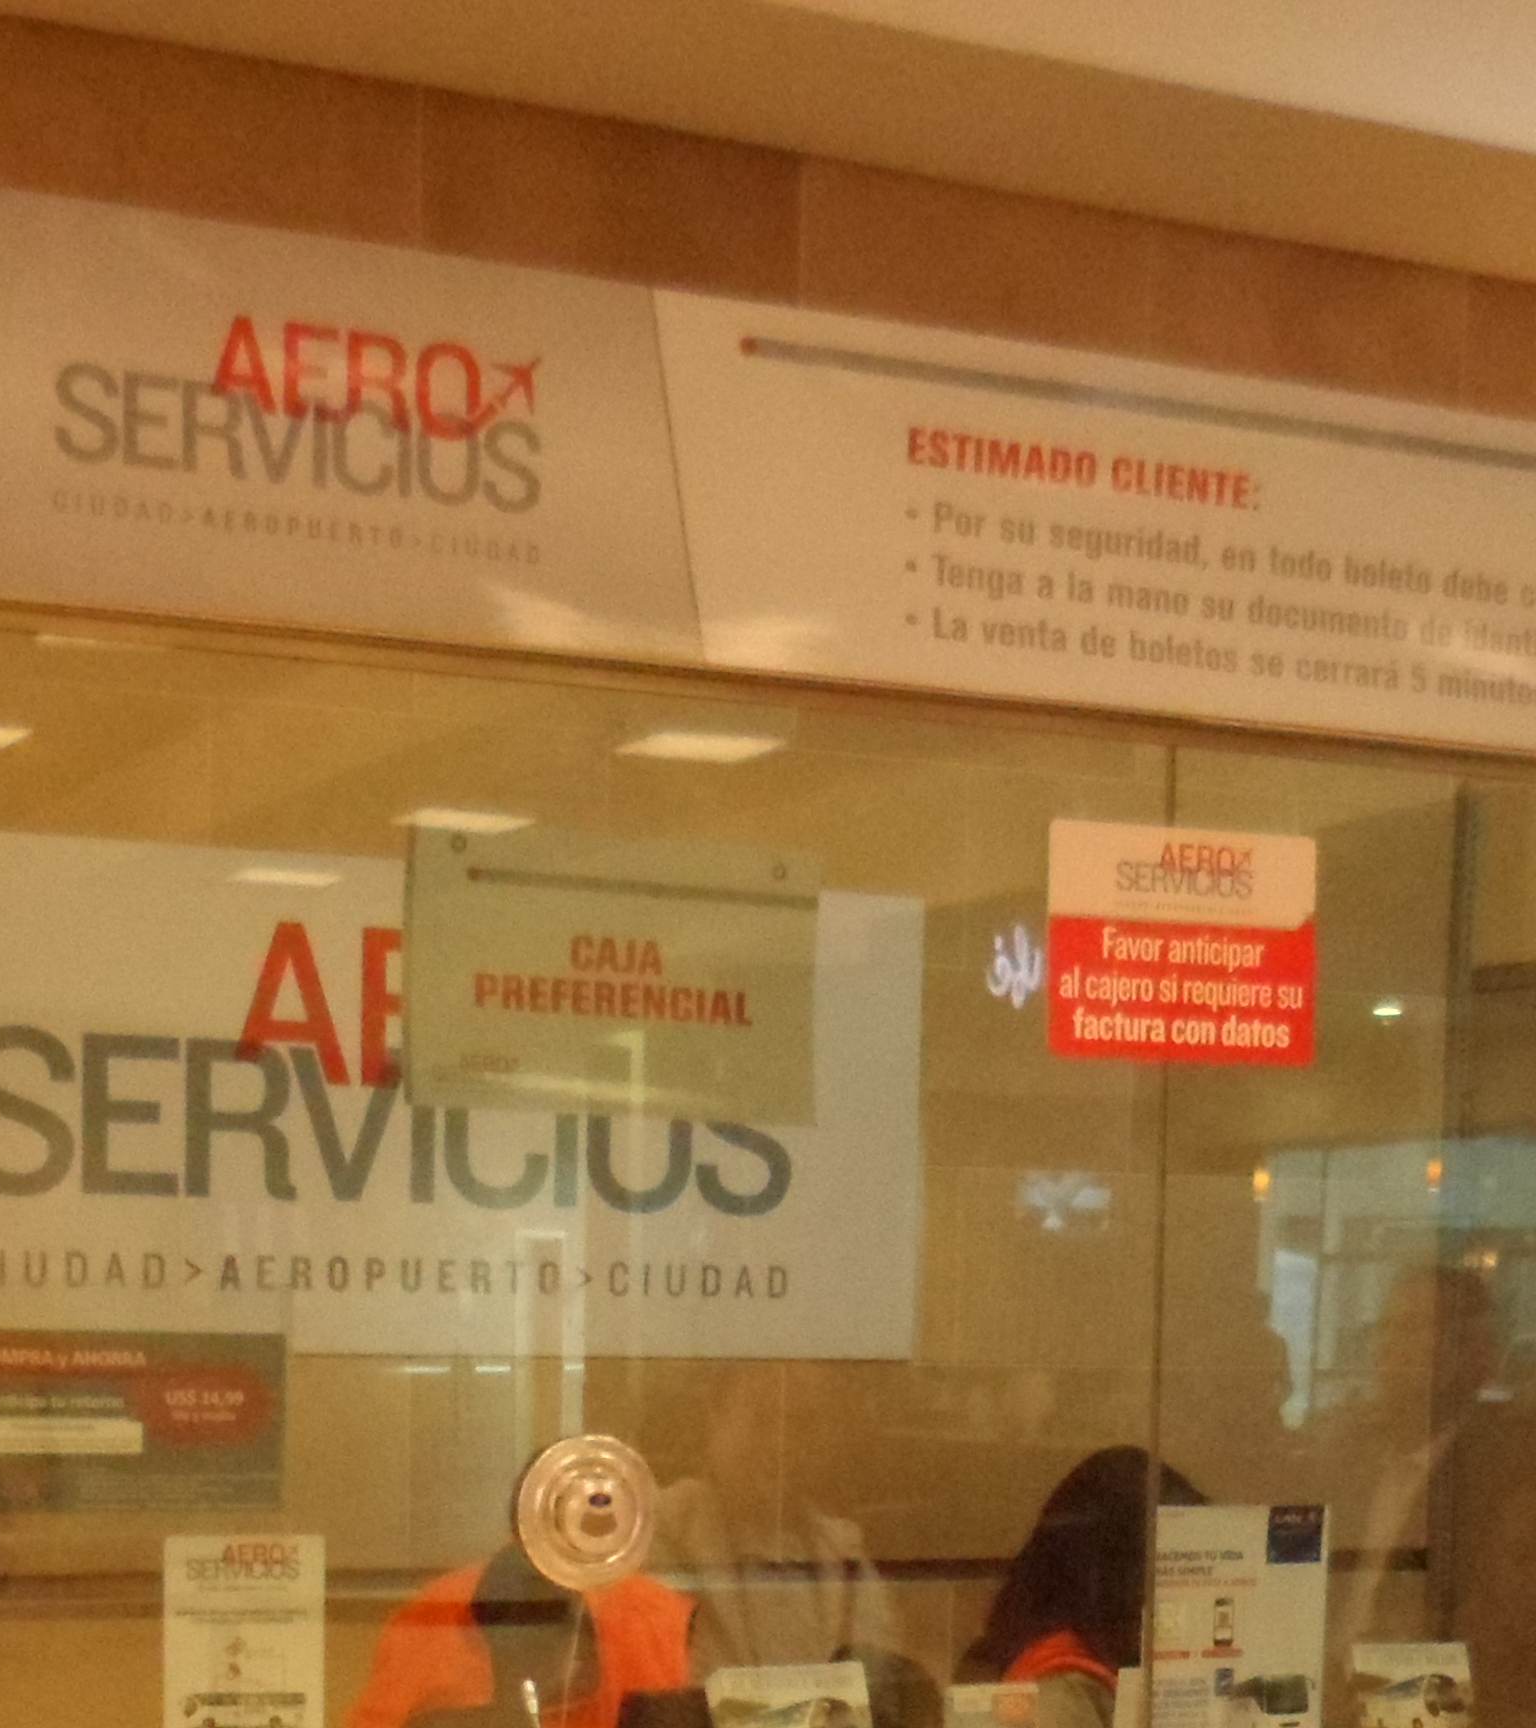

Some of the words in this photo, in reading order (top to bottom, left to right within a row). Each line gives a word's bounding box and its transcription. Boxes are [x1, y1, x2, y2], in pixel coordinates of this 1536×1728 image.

[212, 314, 486, 442] AERO
[52, 360, 542, 516] SERVICIOS
[908, 425, 1096, 488] ESTIMADO
[1111, 455, 1260, 511] CLIENTE:
[933, 502, 987, 537] Por
[1000, 516, 1035, 545] su
[1049, 522, 1207, 570] seguridad,
[1221, 545, 1256, 571] en
[1268, 548, 1332, 582] todo
[1344, 555, 1432, 594] boleto
[1441, 569, 1509, 604] debe
[931, 554, 1024, 600] Tenga
[1037, 573, 1054, 600] a
[1067, 571, 1093, 602] la
[1108, 582, 1189, 615] mano
[1200, 596, 1234, 621] su
[1247, 595, 1409, 641] documento
[1419, 616, 1453, 647] de
[932, 607, 968, 642] La
[981, 619, 1066, 652] venta
[1080, 625, 1116, 657] de
[1129, 630, 1237, 675] boletos
[1250, 652, 1285, 679] se
[1294, 656, 1400, 692] cerrará
[1411, 662, 1427, 693] 5
[1116, 860, 1254, 900] SERVICIOS
[1159, 842, 1237, 878] AERO
[569, 933, 662, 977] CAJA
[1102, 926, 1164, 962] Favor
[1168, 935, 1265, 973] anticipar
[473, 972, 752, 1028] PREFERENCIAL
[1059, 967, 1080, 999] al
[1085, 971, 1153, 1008] cajero
[1159, 974, 1178, 1004] si
[1182, 978, 1273, 1012] requiere
[1278, 984, 1303, 1010] su
[1072, 1006, 1165, 1044] factura
[1171, 1017, 1216, 1047] con
[1221, 1015, 1290, 1049] datos
[73, 1351, 147, 1367] AHORRA
